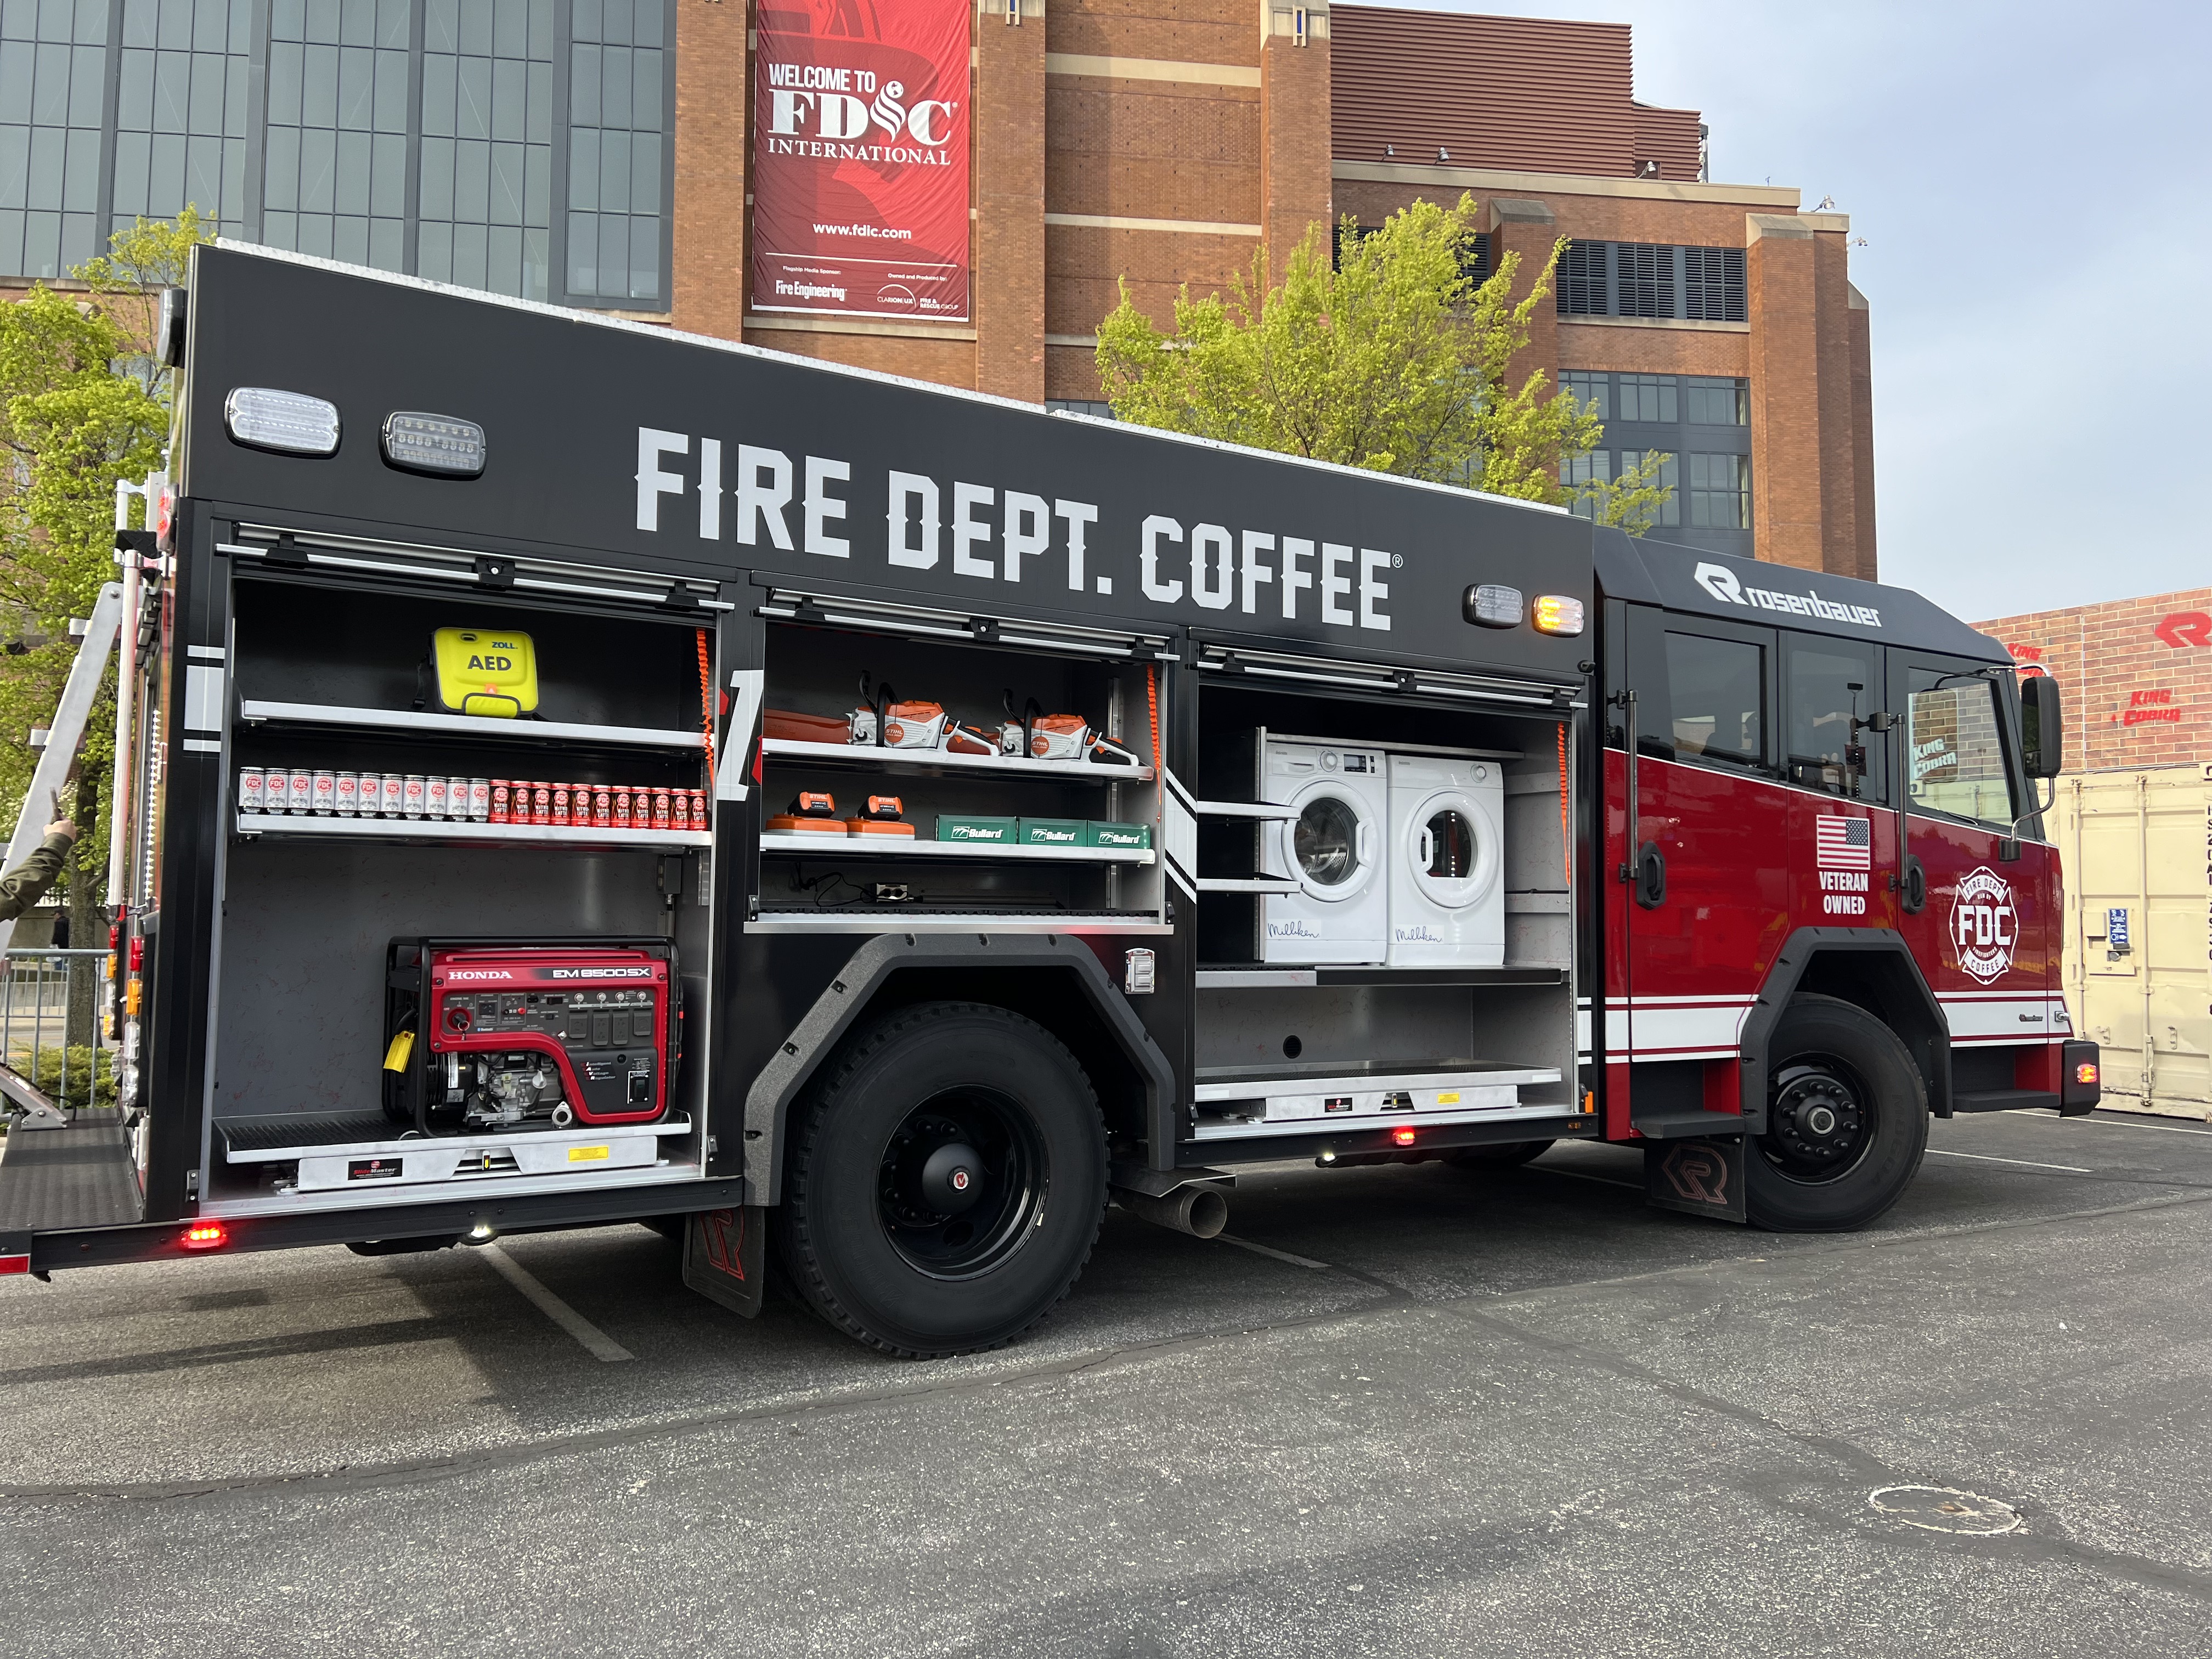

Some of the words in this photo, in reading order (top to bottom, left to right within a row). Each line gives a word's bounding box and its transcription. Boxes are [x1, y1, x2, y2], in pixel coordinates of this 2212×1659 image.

[769, 64, 851, 92] WELCOME
[854, 70, 876, 93] TO
[768, 138, 951, 165] INTERNATIONAL
[813, 223, 912, 239] www.fdic.com
[776, 280, 793, 295] Fire
[794, 281, 845, 302] Engineering
[634, 427, 850, 558] FIRE
[887, 470, 1112, 595] DEPT.
[1745, 587, 1883, 628] rosenbauer
[467, 655, 512, 671] AED
[2130, 689, 2171, 707] KING
[2123, 708, 2181, 726] COBRA
[1913, 738, 1944, 761] KING
[1914, 752, 1957, 779] COBRA
[968, 828, 1003, 838] Bullard
[1046, 831, 1076, 841] Bullard
[1113, 834, 1140, 844] Bullard
[1819, 871, 1869, 891] VETERAN
[1966, 878, 1981, 896] FIRE
[1984, 878, 2001, 895] DEPT
[1823, 895, 1866, 915] OWNED
[1268, 921, 1319, 939] Milliken
[1958, 905, 2011, 945] FDC
[1396, 926, 1443, 943] Milliken
[1972, 946, 1997, 958] FIREFIGHTERS
[448, 970, 513, 980] HONDA
[1971, 959, 2000, 973] COFFEE
